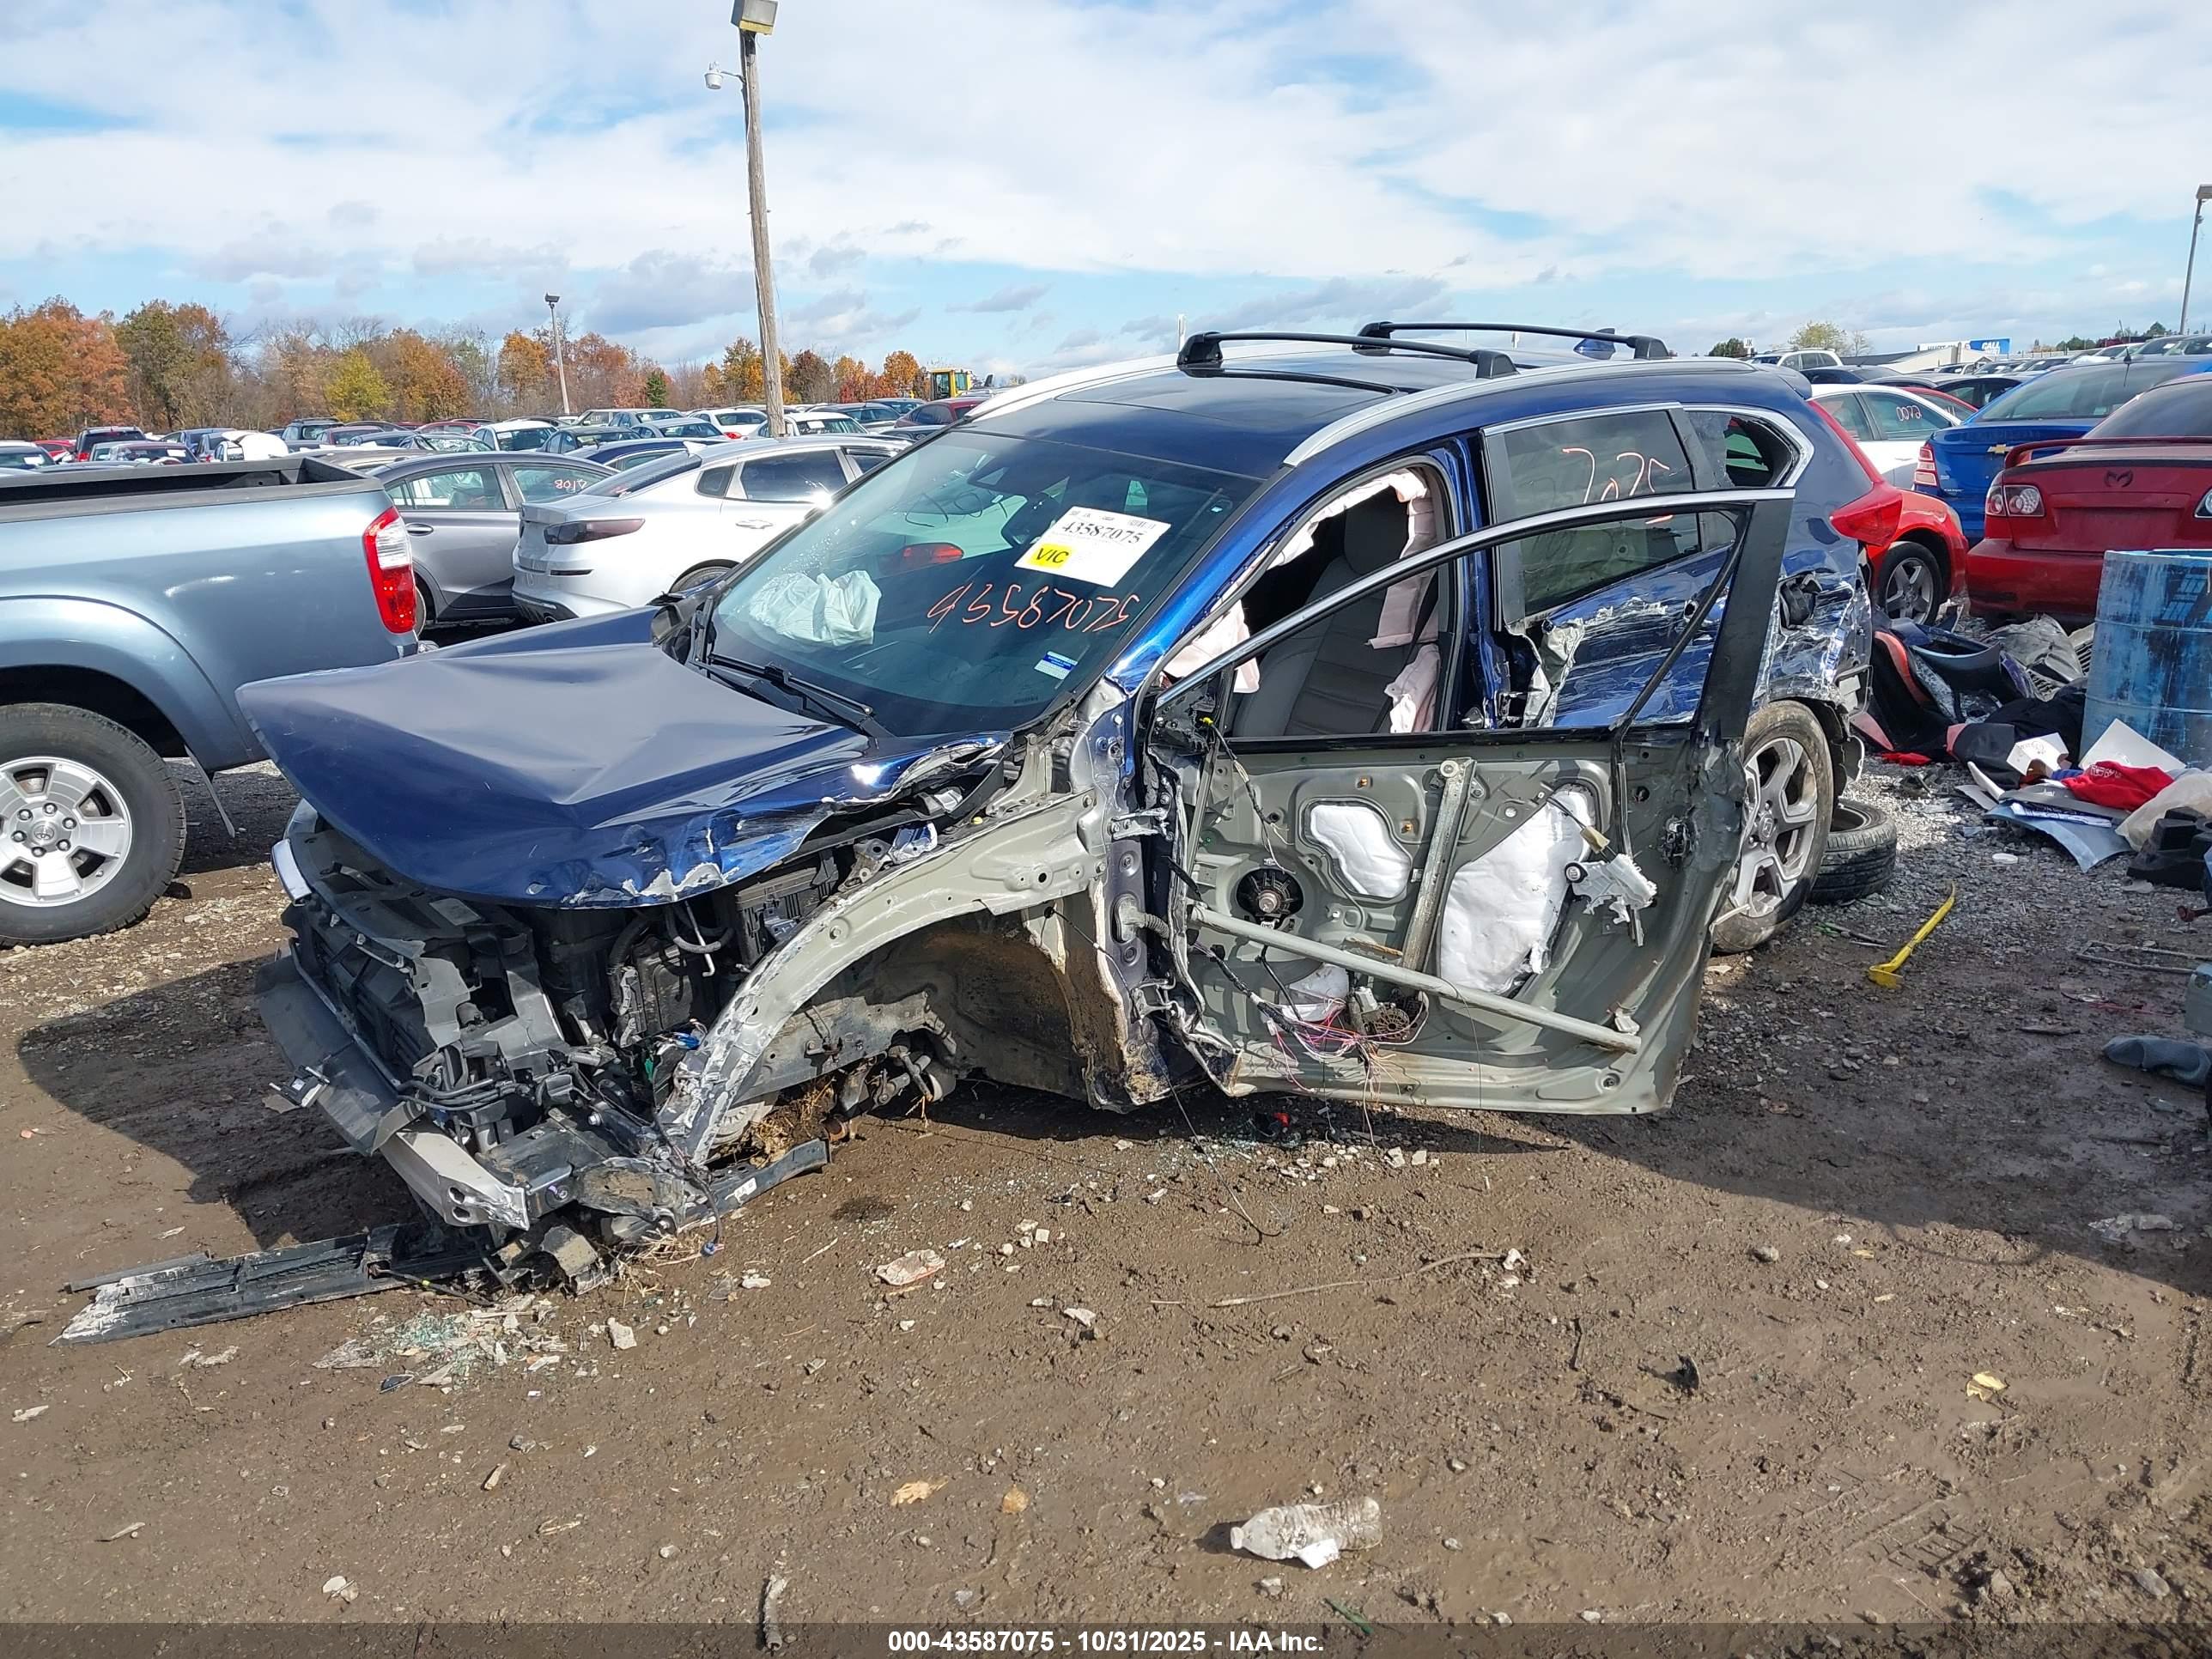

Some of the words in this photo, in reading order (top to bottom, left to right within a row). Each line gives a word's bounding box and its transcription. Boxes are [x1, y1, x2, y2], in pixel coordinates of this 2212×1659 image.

[1896, 404, 1923, 422] 0072
[1061, 521, 1145, 544] 43587075
[1036, 547, 1069, 564] VIC
